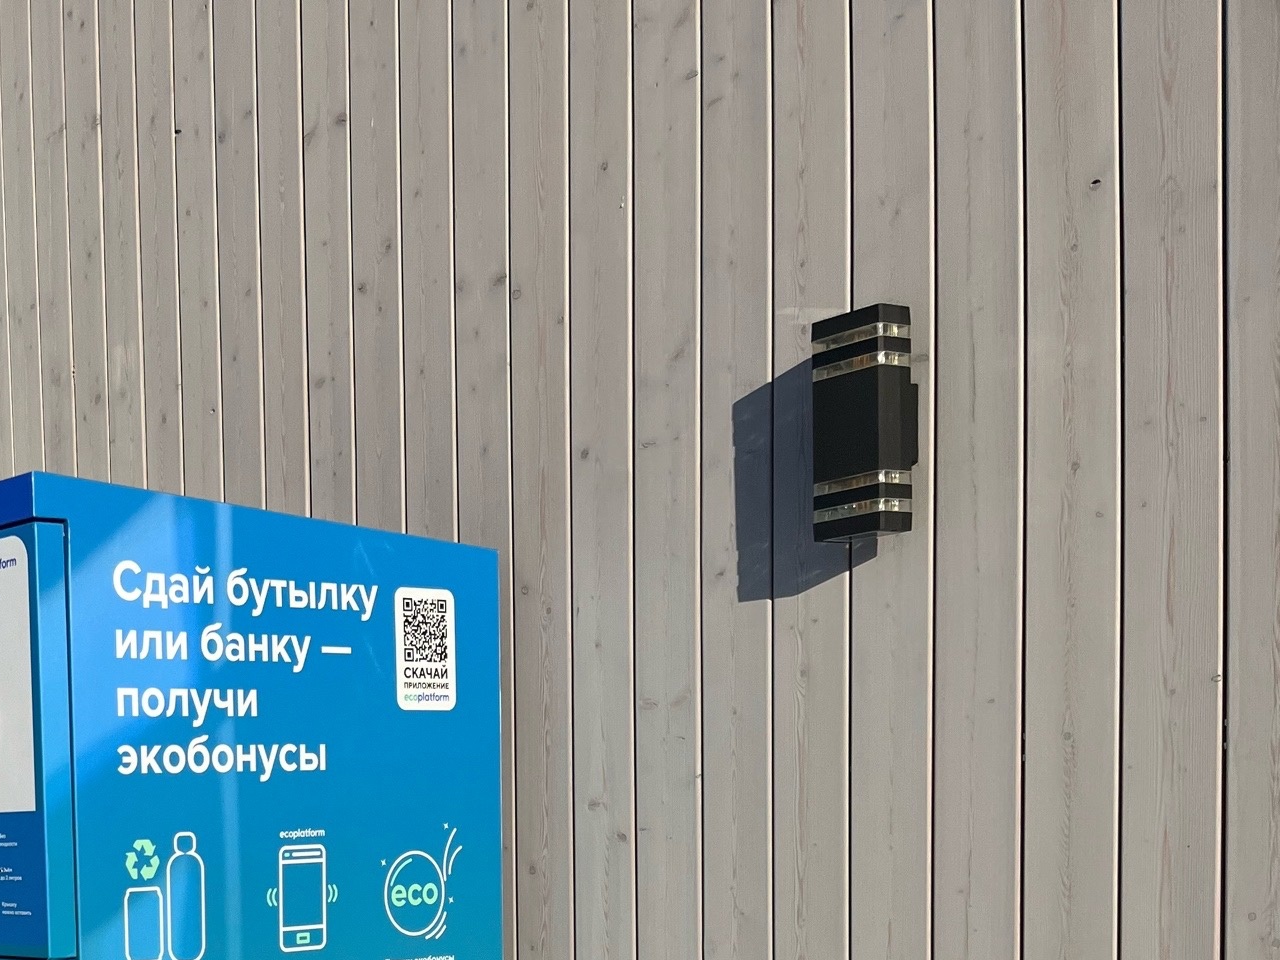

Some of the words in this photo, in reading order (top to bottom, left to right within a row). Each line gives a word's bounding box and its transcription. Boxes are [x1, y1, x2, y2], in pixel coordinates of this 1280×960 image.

[113, 560, 213, 609] Сдай
[227, 568, 378, 621] бутылку
[115, 629, 187, 660] или
[201, 623, 311, 673] банку
[404, 665, 448, 679] СКАЧАЙ
[404, 682, 449, 690] ПРИЛОЖЕНИЕ
[404, 692, 449, 703] ecoplatform
[117, 688, 258, 727] получи
[117, 736, 327, 782] экобонусы
[279, 828, 326, 840] ecoplatform
[391, 882, 439, 907] eco
